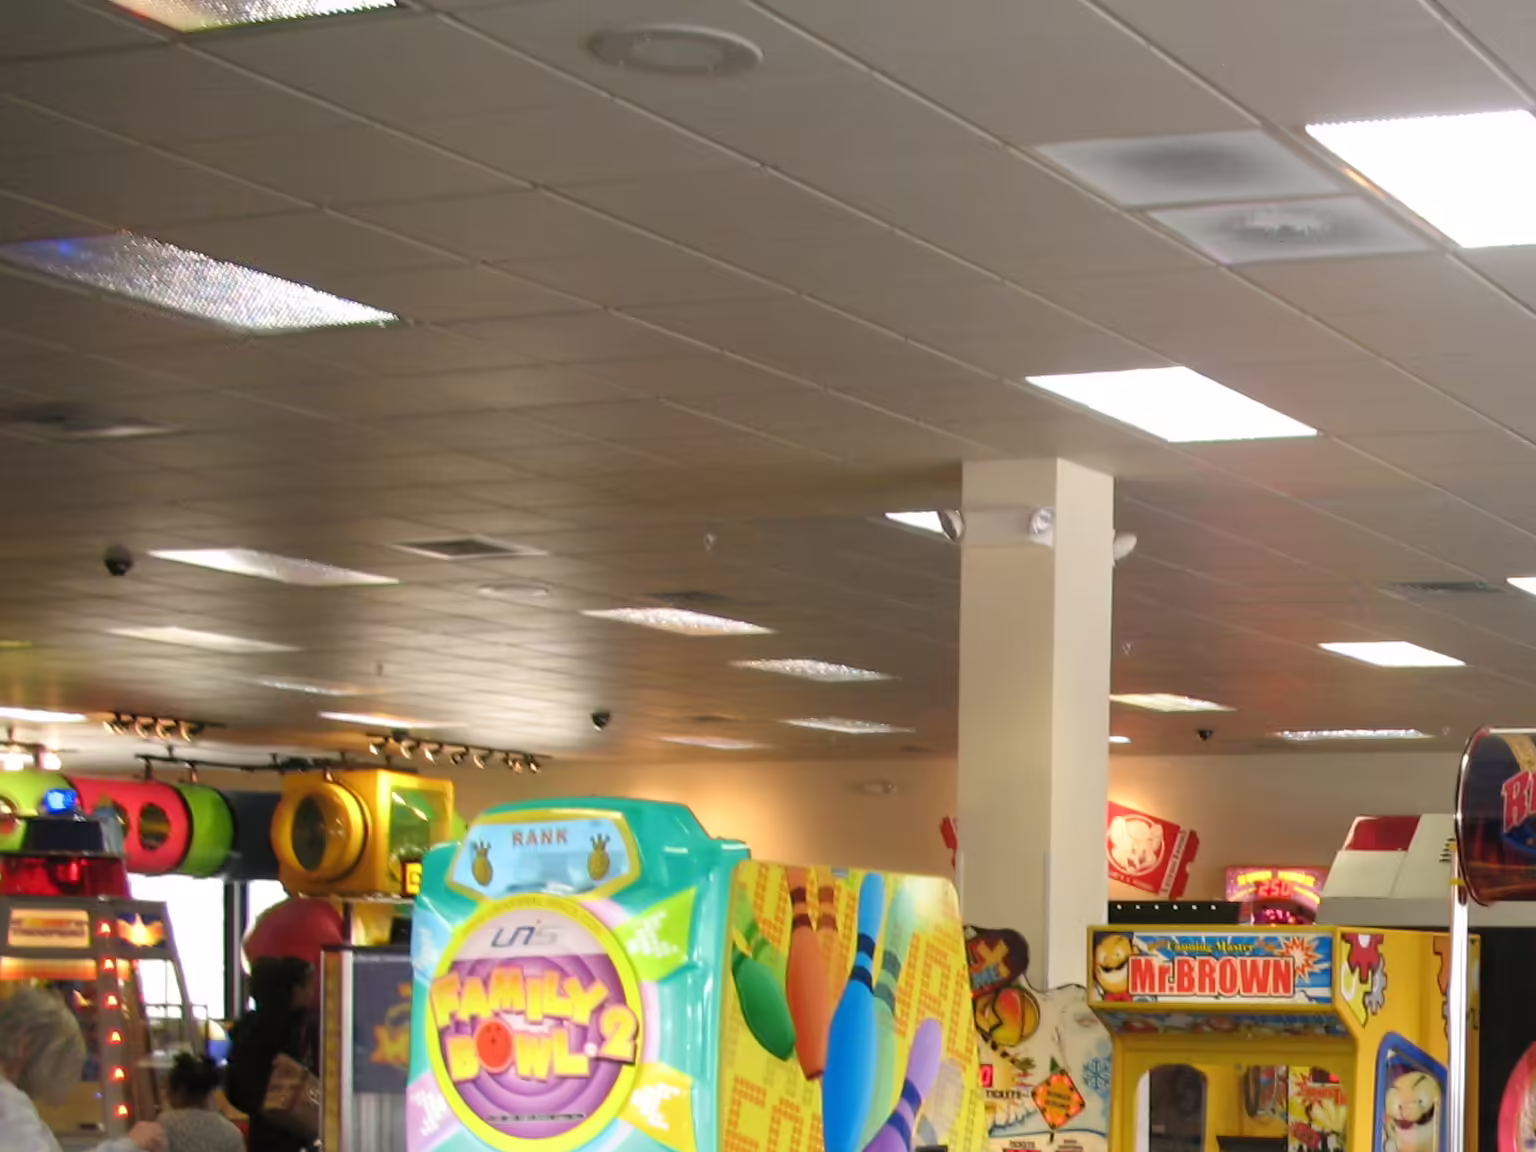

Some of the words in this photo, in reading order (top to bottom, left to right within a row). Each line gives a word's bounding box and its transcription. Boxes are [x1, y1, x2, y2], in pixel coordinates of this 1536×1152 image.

[511, 828, 569, 847] RANK
[1257, 879, 1292, 897] 250
[431, 964, 610, 1031] FAMILY
